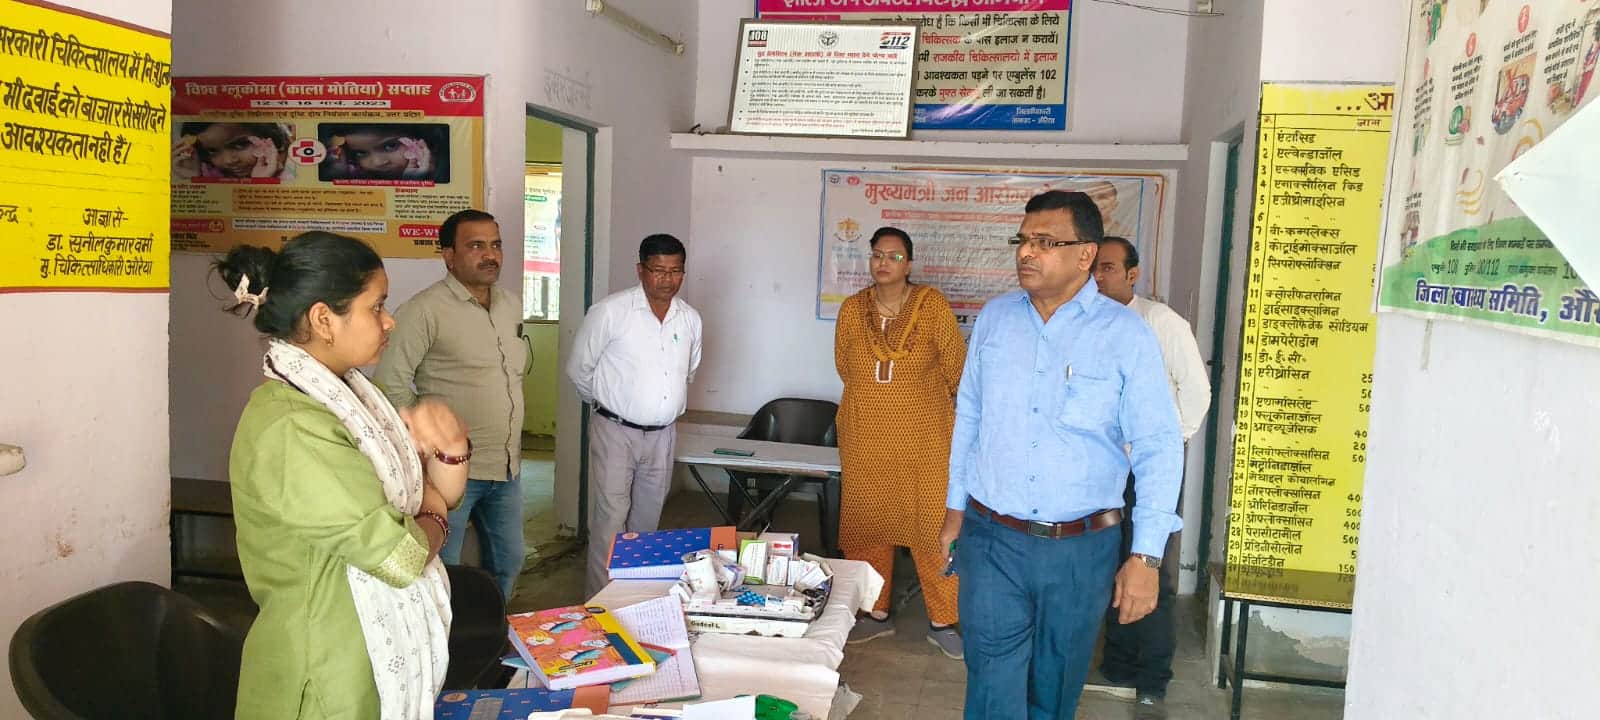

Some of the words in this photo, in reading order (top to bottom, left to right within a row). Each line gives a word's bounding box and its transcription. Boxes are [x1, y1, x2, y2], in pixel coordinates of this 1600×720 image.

[1030, 14, 1039, 26] के
[891, 36, 910, 45] 112
[994, 35, 1018, 46] इलाज
[1021, 36, 1029, 45] न
[51, 32, 129, 78] चिकित्सालय
[130, 51, 143, 80] में
[1034, 53, 1058, 63] इलाज
[923, 70, 968, 81] आवश्यकता
[1040, 70, 1057, 80] 102
[185, 82, 217, 96] विश्व
[221, 82, 276, 99] ग्लूकोमा
[388, 84, 432, 96] सप्ताह
[1008, 86, 1034, 98] सकती
[24, 82, 60, 118] दवाई
[59, 85, 84, 120] को
[81, 95, 124, 128] बाजार
[1, 122, 89, 160] आवश्यकता
[1263, 150, 1268, 159] 2
[1261, 166, 1267, 174] 3
[1260, 180, 1266, 188] 4
[865, 179, 935, 204] मुख्यमंत्री
[941, 186, 968, 202] जन
[1260, 195, 1265, 205] 5
[1258, 212, 1264, 221] 6
[1256, 226, 1261, 235] 7
[1250, 289, 1259, 298] 11
[1416, 279, 1449, 304] जिला
[1249, 304, 1257, 313] 12
[1247, 319, 1255, 328] 13
[1246, 335, 1254, 345] 14
[1244, 353, 1252, 362] 15
[1244, 367, 1253, 377] 16
[1242, 382, 1250, 392] 17
[1241, 397, 1248, 406] 18
[1240, 409, 1248, 418] 19
[1239, 422, 1247, 430] 20
[1238, 433, 1246, 443] 21
[1237, 447, 1245, 456] 22
[1235, 472, 1243, 481] 24
[1234, 486, 1243, 495] 25
[1232, 500, 1242, 509] 26
[1231, 513, 1240, 523] 27
[1231, 527, 1240, 537] 28
[1230, 540, 1239, 550] 29
